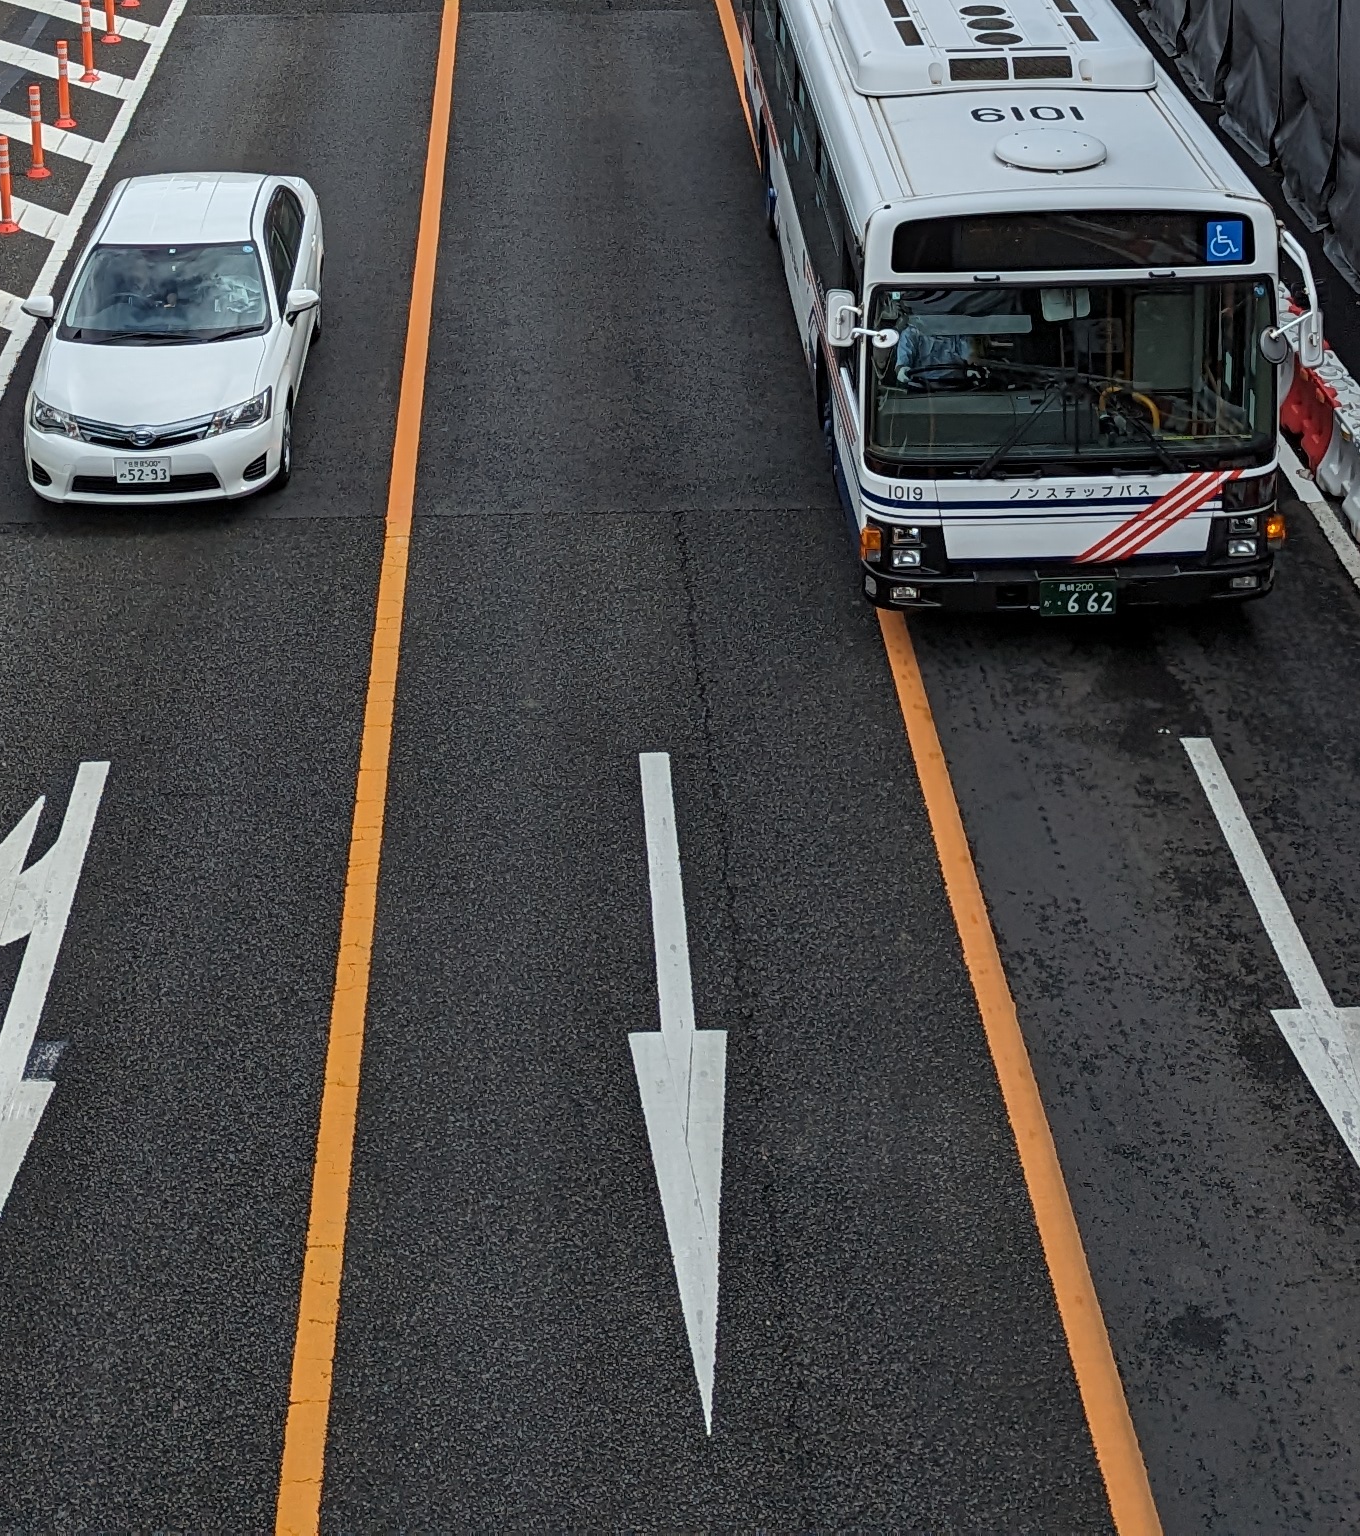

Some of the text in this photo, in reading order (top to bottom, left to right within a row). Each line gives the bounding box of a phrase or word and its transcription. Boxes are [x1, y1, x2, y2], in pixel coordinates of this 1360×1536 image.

[128, 468, 167, 481] 52-93
[888, 484, 924, 501] 1019
[1009, 484, 1151, 501] ノンステップバス
[1075, 582, 1094, 592] 200
